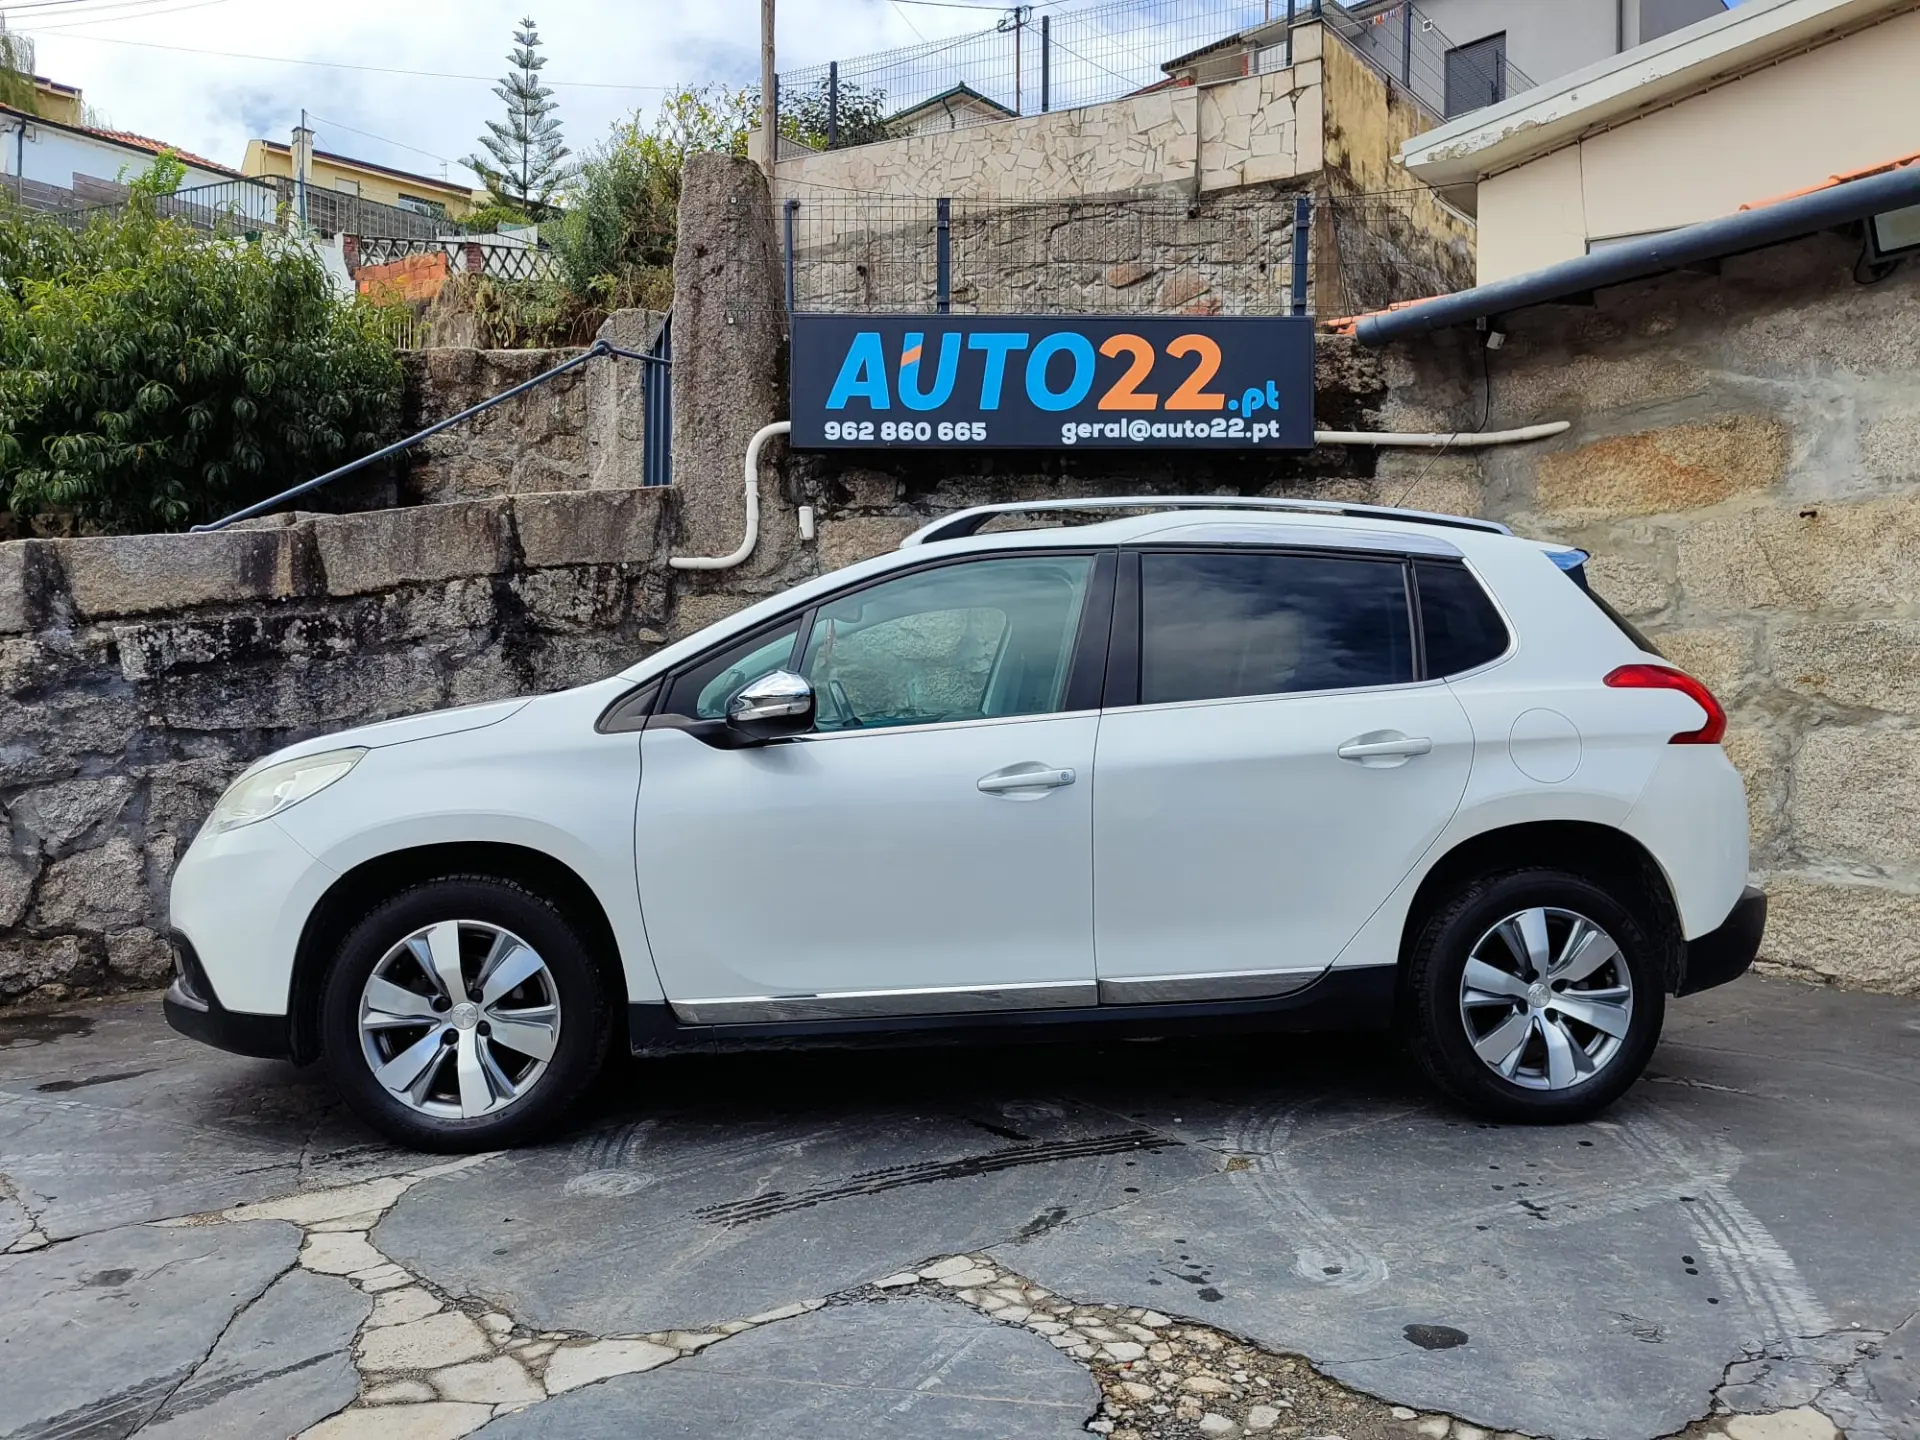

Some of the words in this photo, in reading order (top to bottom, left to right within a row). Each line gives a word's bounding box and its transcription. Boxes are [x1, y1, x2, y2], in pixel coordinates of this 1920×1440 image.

[824, 420, 875, 441] 962
[881, 421, 932, 441] 860
[938, 421, 987, 441] 665
[1061, 418, 1280, 444] geral@auto22.pt
